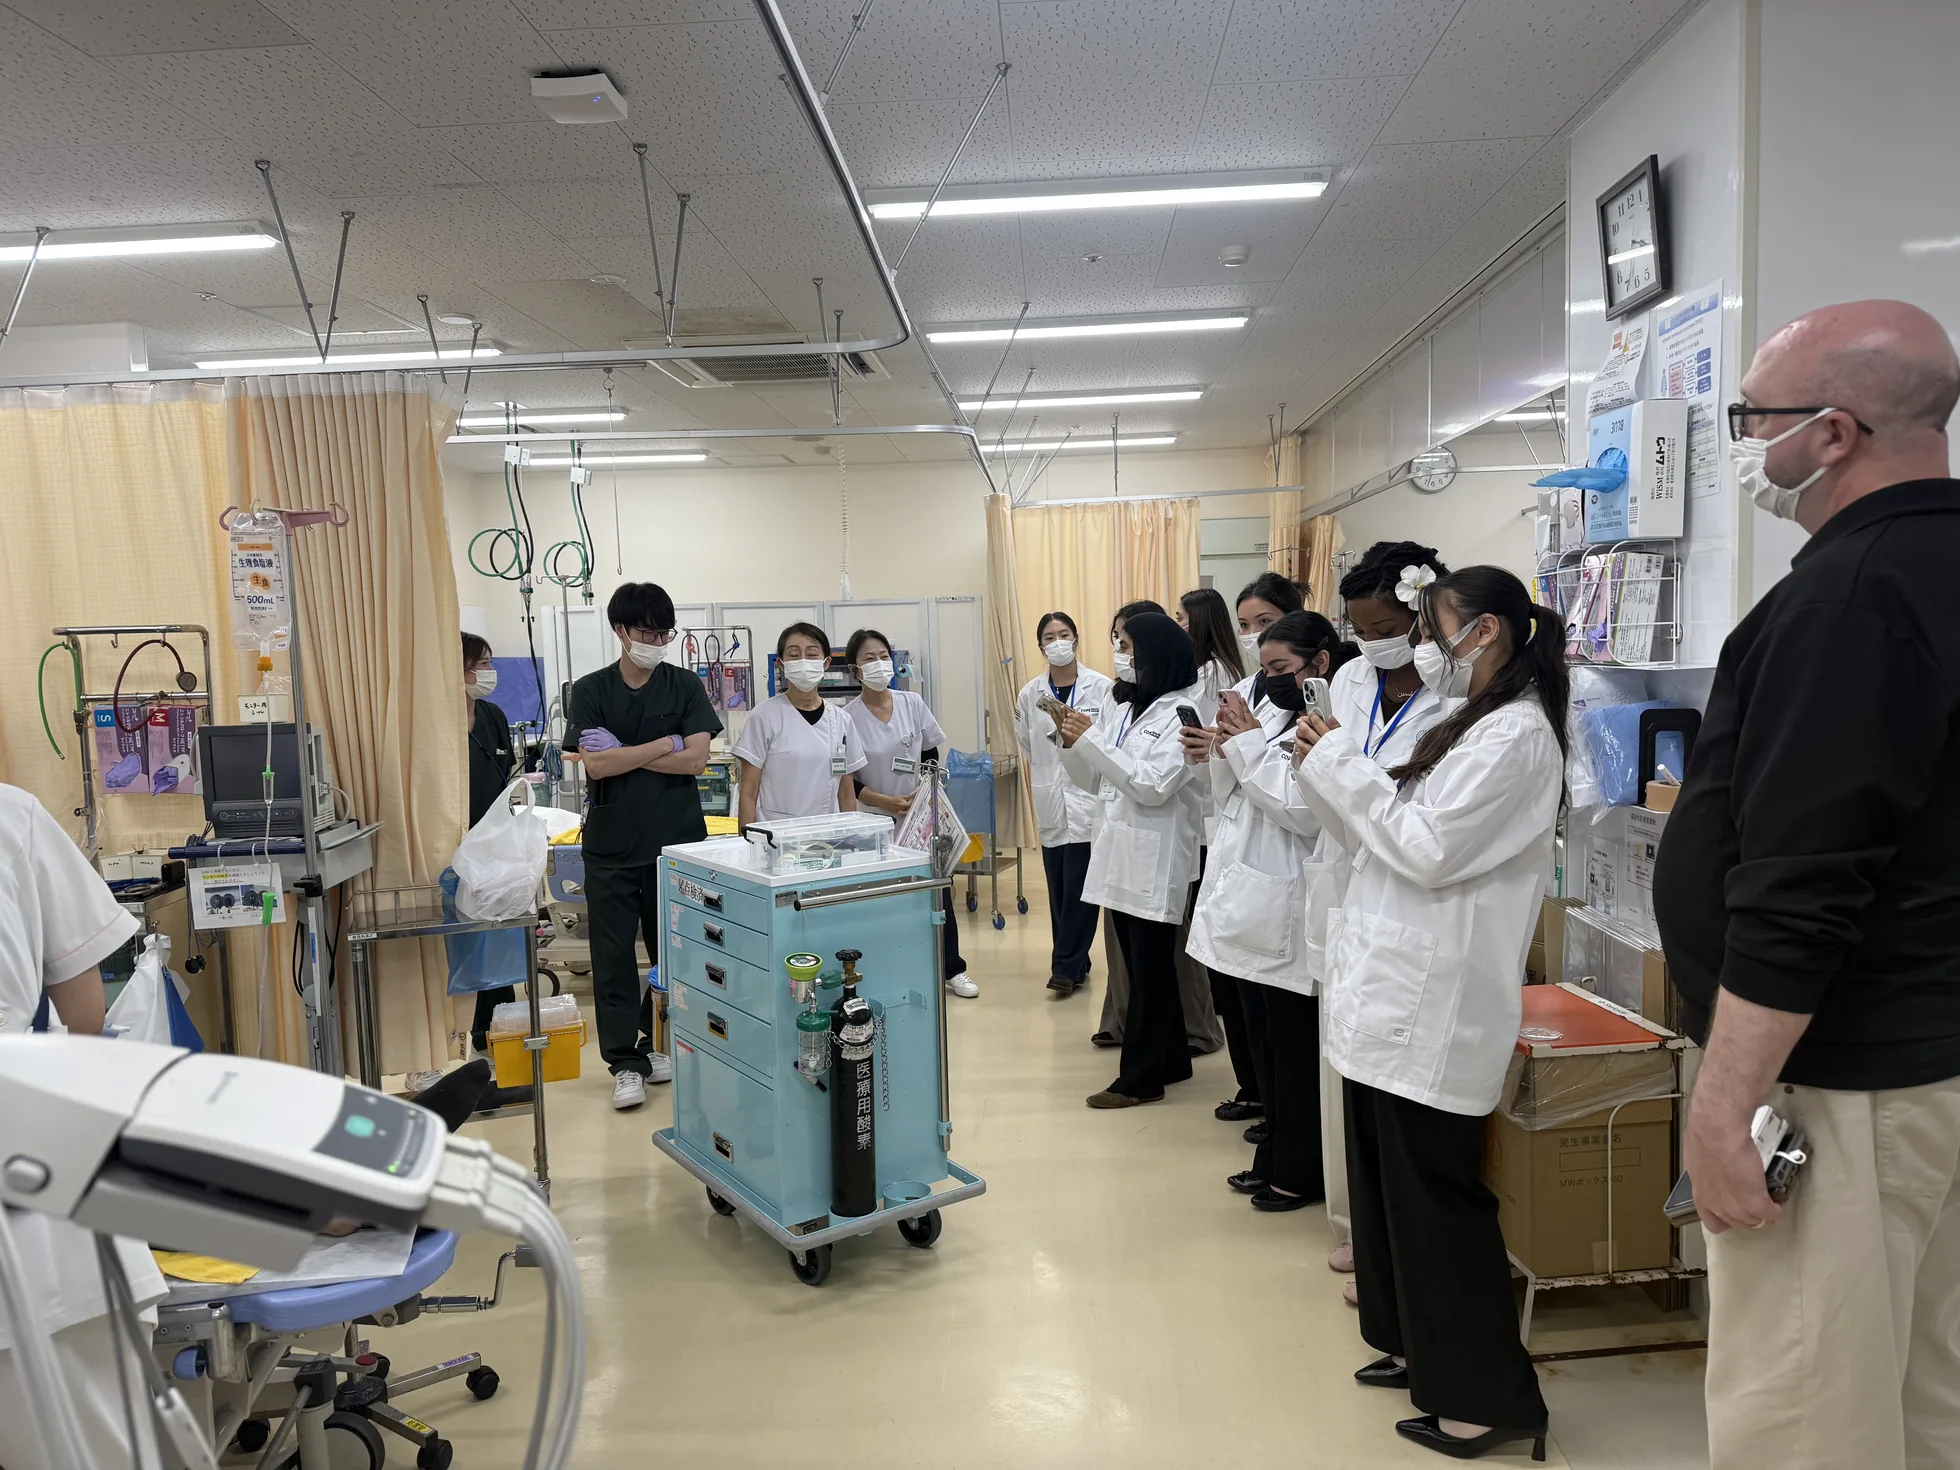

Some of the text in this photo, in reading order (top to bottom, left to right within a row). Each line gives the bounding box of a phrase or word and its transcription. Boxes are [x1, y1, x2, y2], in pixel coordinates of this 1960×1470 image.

[1626, 194, 1635, 209] 12
[1617, 203, 1625, 218] 11
[1611, 222, 1620, 237] 10
[1616, 270, 1623, 284] 8
[1634, 275, 1640, 288] 6
[1644, 268, 1650, 281] 5
[1624, 278, 1631, 292] 7
[1656, 437, 1665, 465] ムトウ
[239, 558, 273, 568] 生理食塩液
[247, 595, 275, 604] 500mL
[100, 714, 112, 722] S
[155, 713, 165, 722] M
[856, 1061, 871, 1150] 医療用酸素
